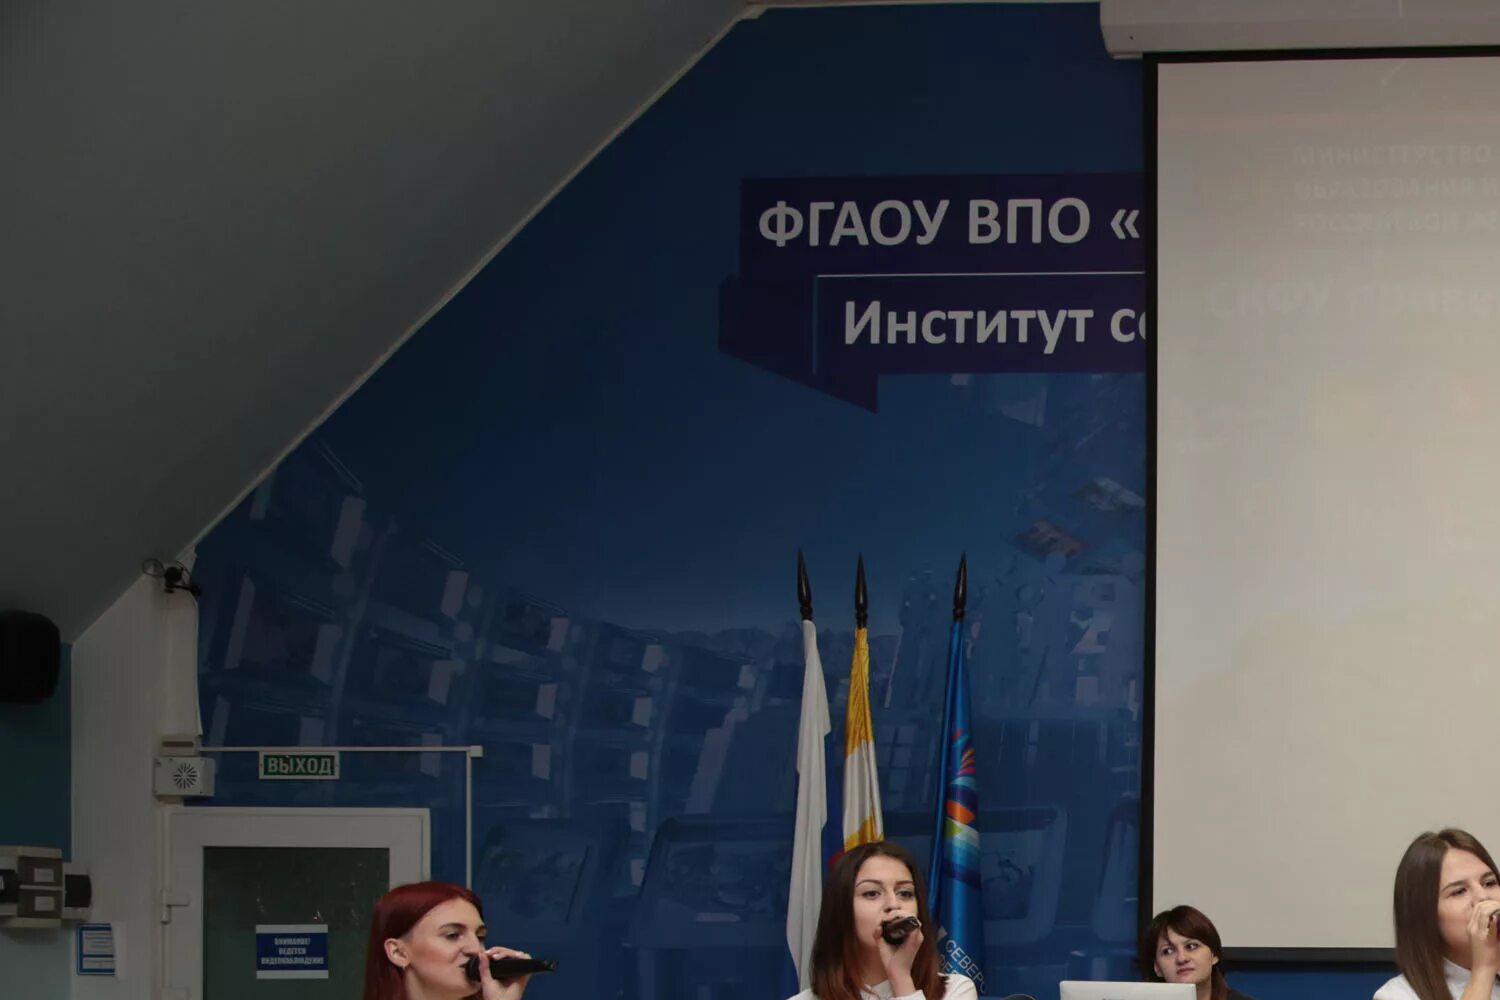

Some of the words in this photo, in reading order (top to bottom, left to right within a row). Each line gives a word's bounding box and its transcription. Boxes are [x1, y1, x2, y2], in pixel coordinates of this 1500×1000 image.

[758, 200, 950, 247] ФГАОУ
[968, 198, 1091, 244] ВПО
[844, 300, 1094, 354] Институт
[267, 757, 334, 775] ВЫХОД
